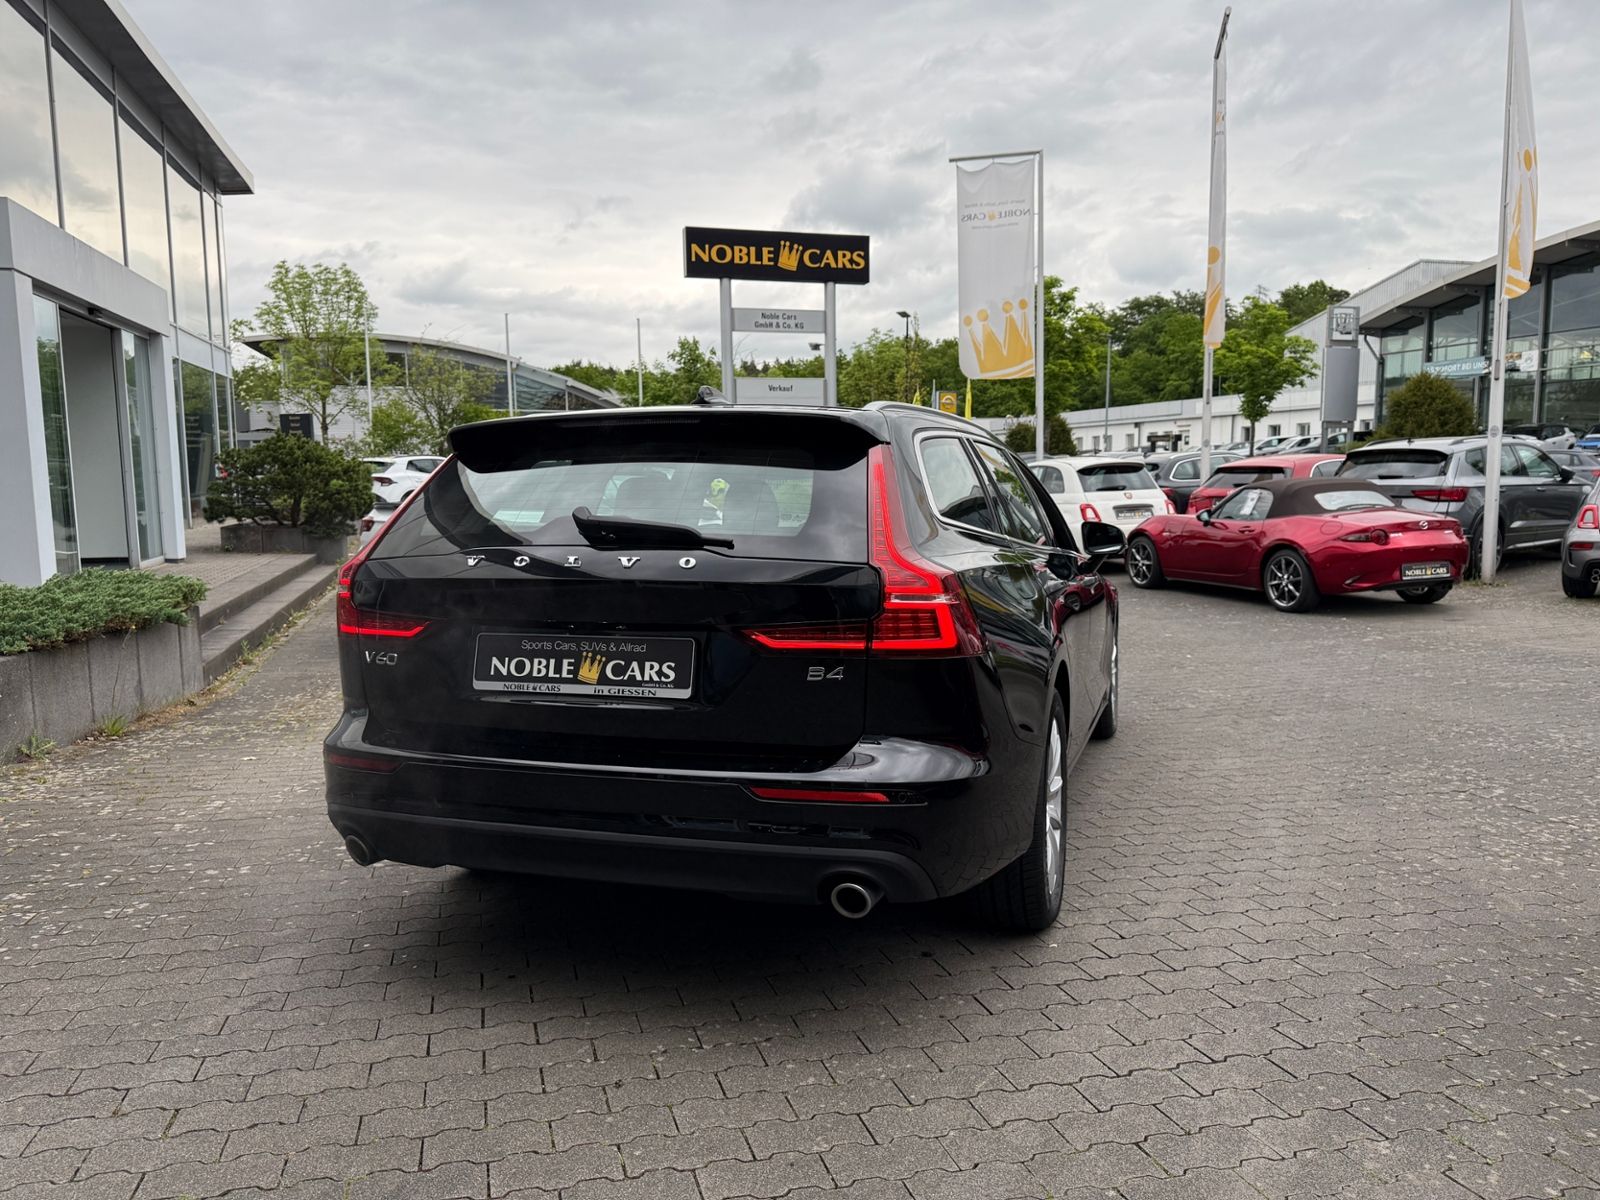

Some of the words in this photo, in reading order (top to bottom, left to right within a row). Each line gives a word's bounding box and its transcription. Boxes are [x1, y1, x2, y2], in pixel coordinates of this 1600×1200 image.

[691, 243, 774, 265] NOBLE
[803, 249, 866, 269] CARS
[761, 312, 780, 321] Noble
[782, 312, 797, 321] Cars
[754, 321, 774, 329] GmbH
[775, 321, 781, 329] &
[795, 322, 804, 330] KG
[768, 384, 793, 392] Verkauf
[466, 555, 696, 569] VOLVO
[520, 640, 552, 650] Sports
[554, 640, 579, 651] Cars,
[580, 641, 607, 651] SUVs
[608, 642, 617, 651] &
[618, 643, 647, 652] Allrad
[365, 651, 398, 665] V60
[490, 657, 575, 679] NOBLE
[605, 660, 676, 682] CARS
[806, 666, 844, 681] B4
[503, 683, 531, 691] NOBLE
[538, 684, 561, 692] CARS
[607, 688, 657, 697] GIESSEN
